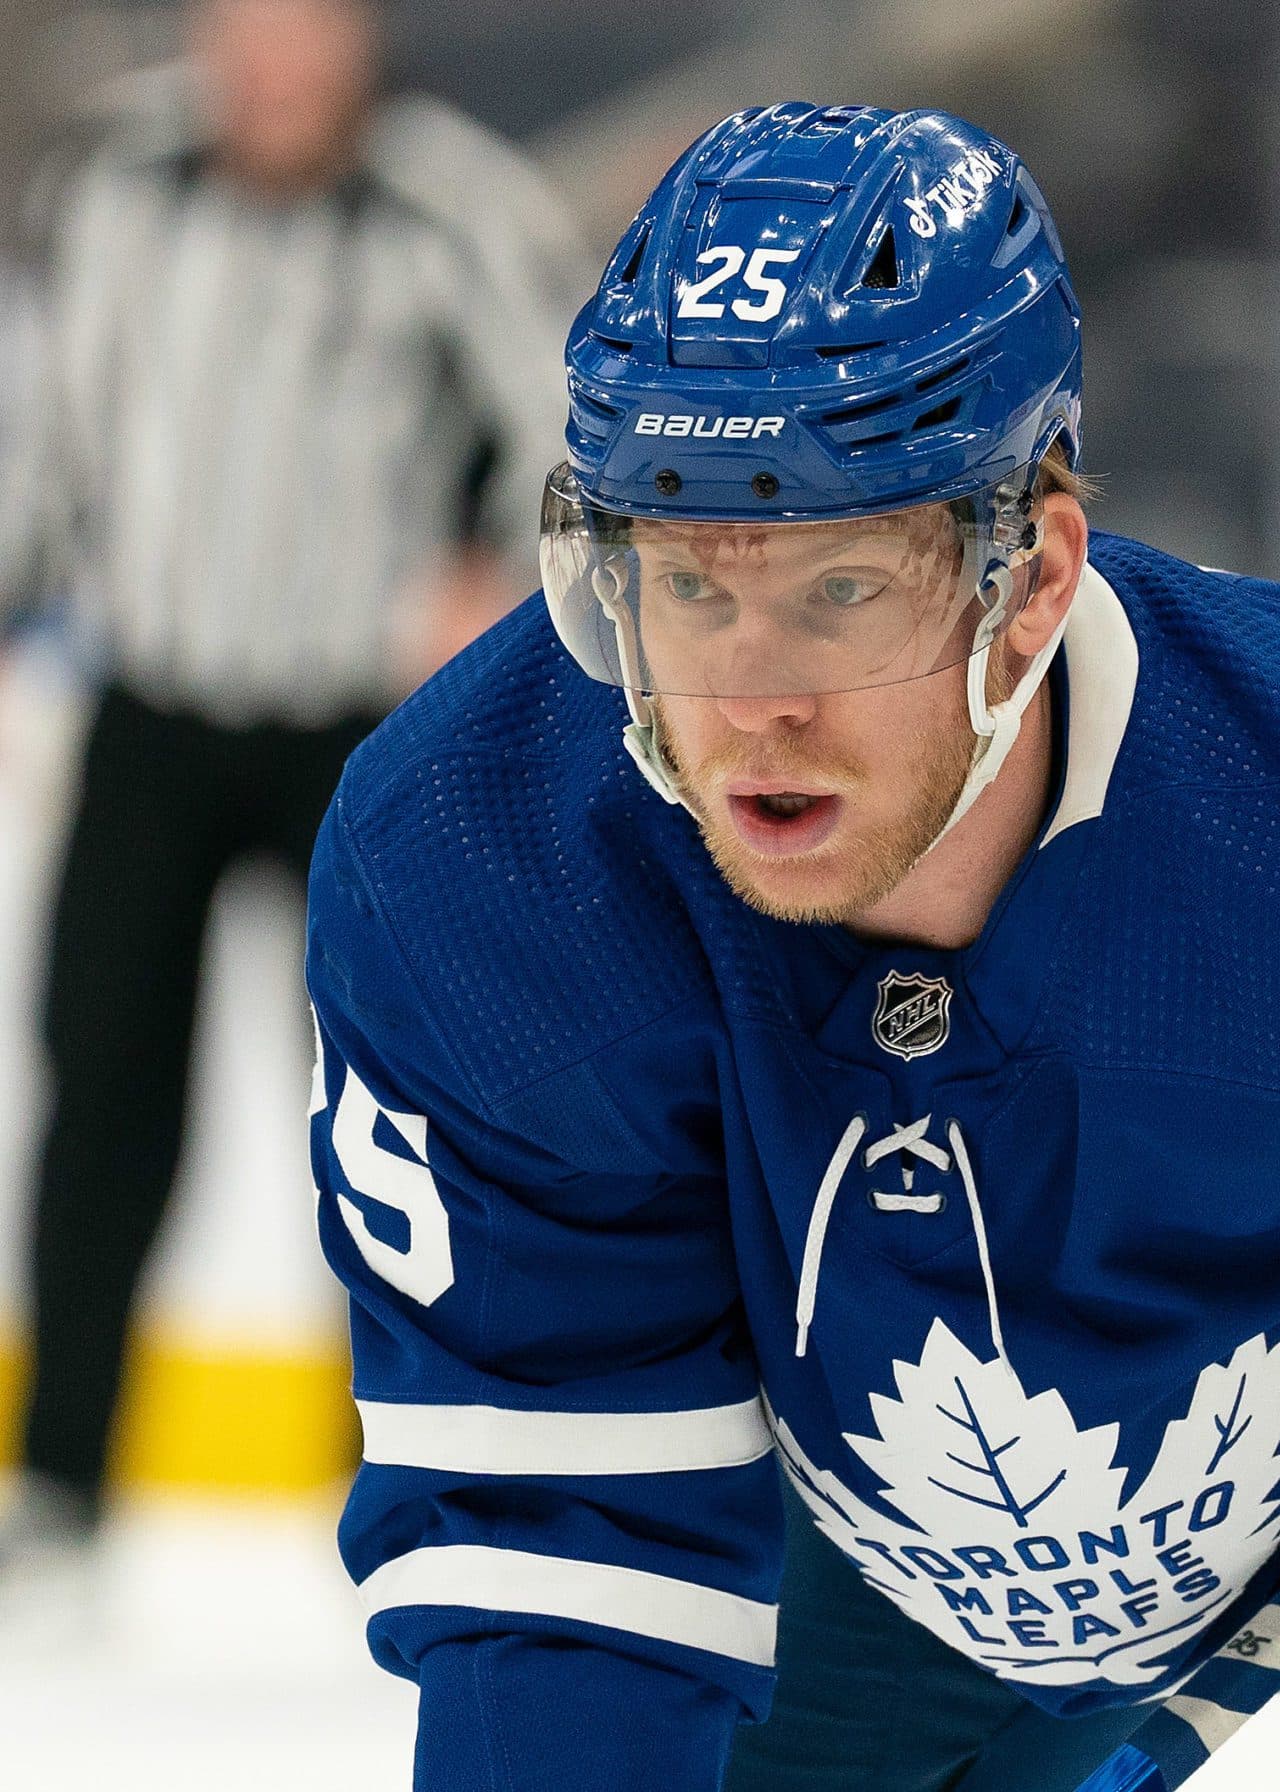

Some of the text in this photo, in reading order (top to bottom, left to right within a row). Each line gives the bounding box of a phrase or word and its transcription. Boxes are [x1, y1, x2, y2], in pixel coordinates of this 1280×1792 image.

[924, 147, 1003, 211] TikTok
[676, 245, 801, 323] 25
[634, 413, 786, 439] BAUER
[888, 994, 938, 1038] NHL
[308, 1000, 455, 1308] 5
[855, 1479, 1237, 1580] TORONTO
[933, 1538, 1206, 1616] MAPLE
[955, 1567, 1222, 1649] LEAFS
